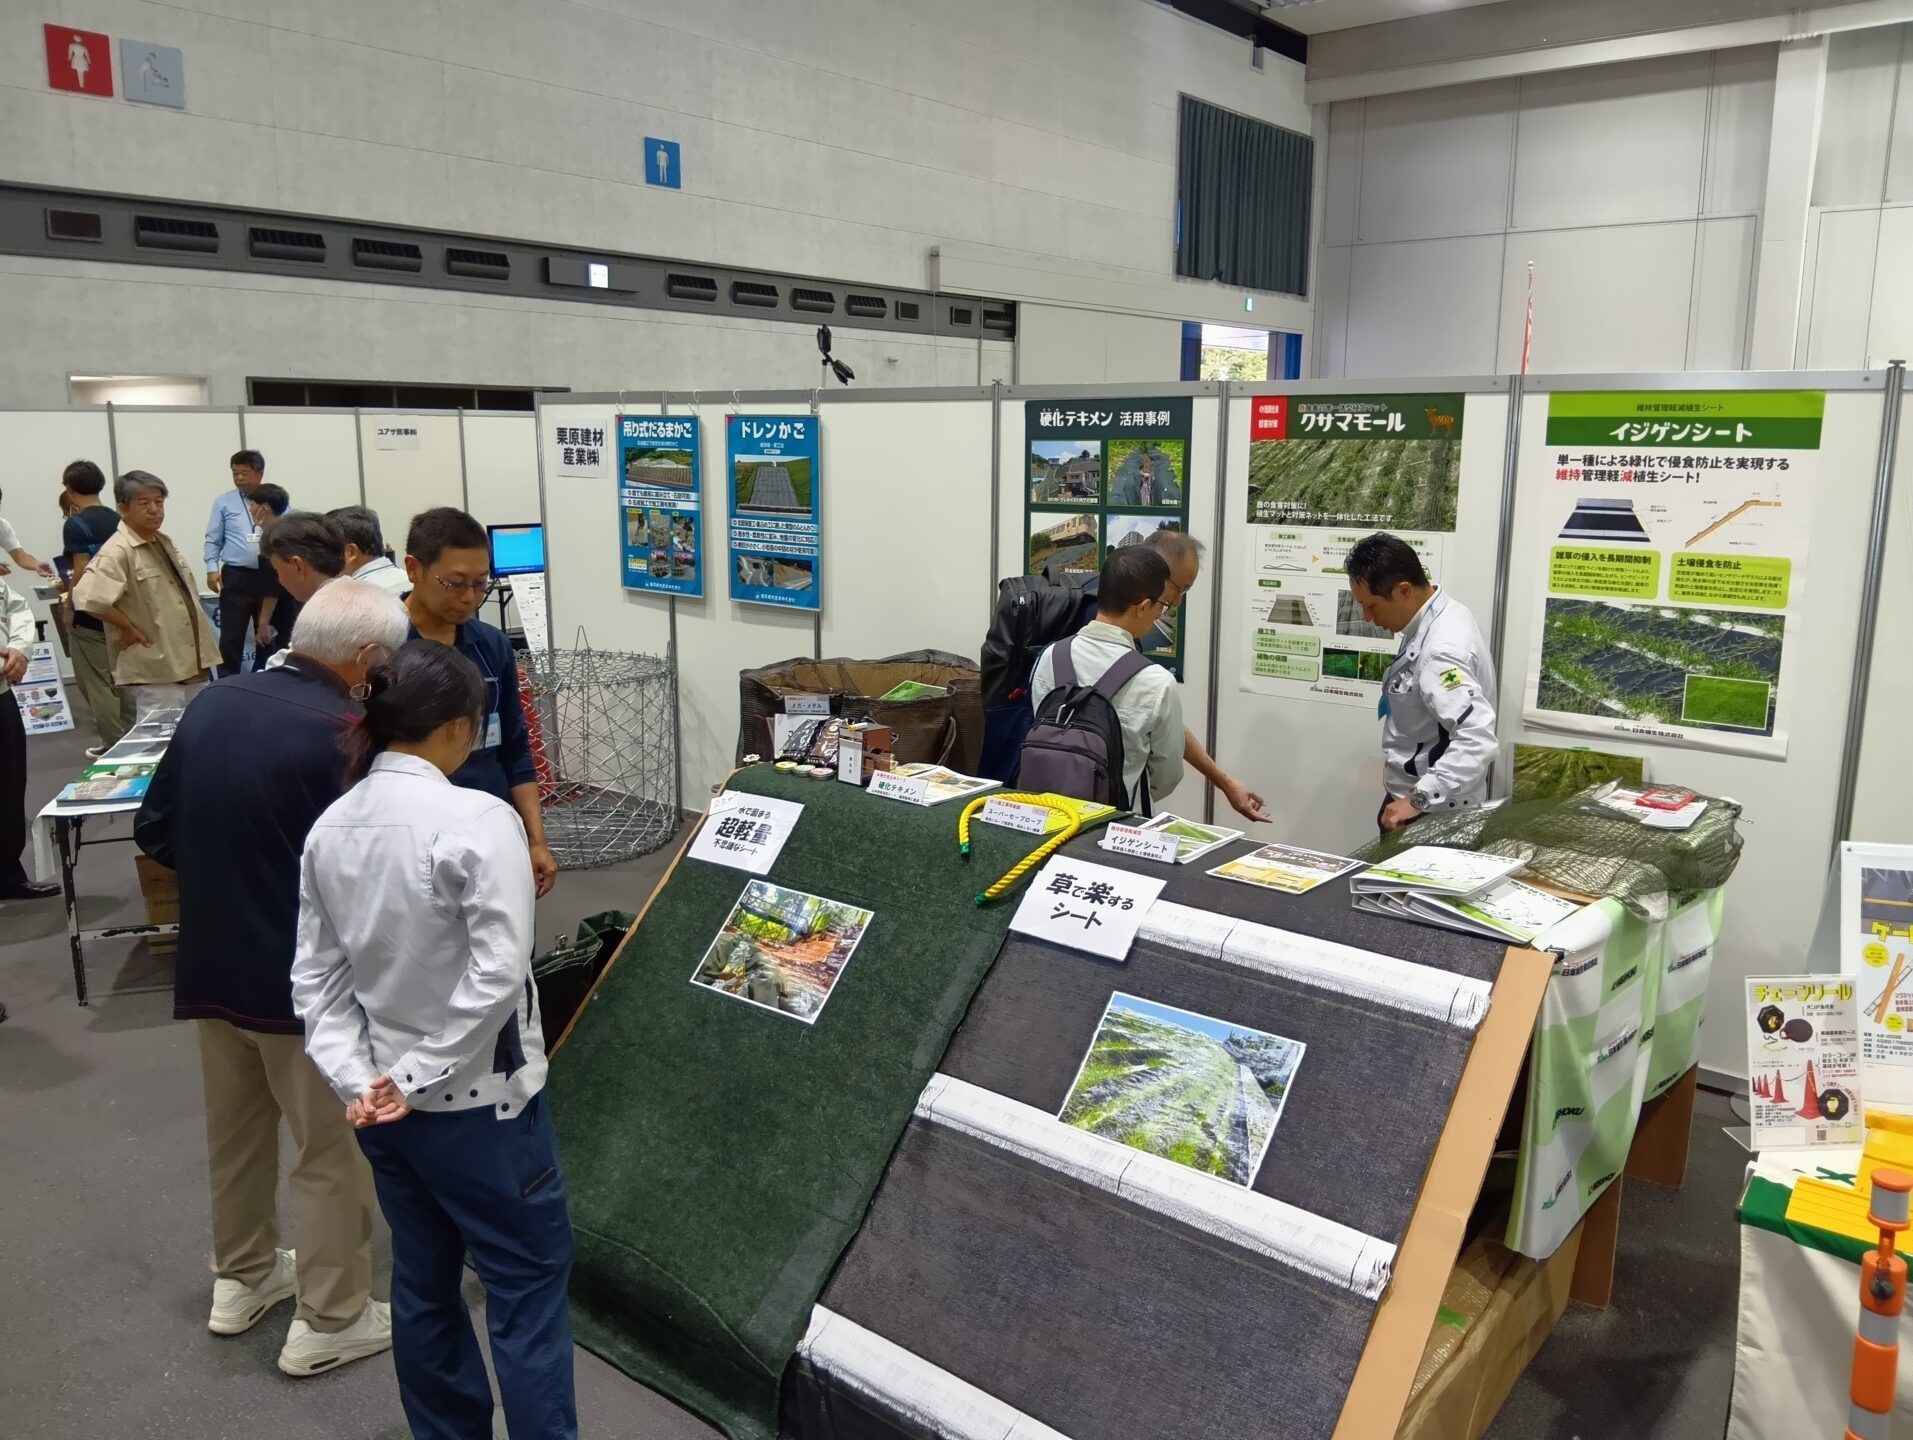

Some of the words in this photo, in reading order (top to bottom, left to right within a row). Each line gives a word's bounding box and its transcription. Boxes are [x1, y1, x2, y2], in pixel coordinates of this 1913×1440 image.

[1637, 403, 1724, 412] 維持管理軽減植生シート
[1040, 411, 1113, 427] 硬化テキメン
[1119, 410, 1171, 427] 活用事例
[1300, 412, 1406, 432] クサマモール
[556, 427, 604, 446] 栗原建材
[623, 421, 693, 439] 吊り式だるまかご
[741, 421, 805, 440] ドレンかご
[1609, 422, 1753, 443] イジゲンシート
[1557, 453, 1790, 471] 単一種による緑化で侵食防止を実現する
[1555, 551, 1652, 565] 雑草の侵入を長期間抑制
[1676, 558, 1742, 570] 土壌侵食を防止
[878, 781, 917, 796] 硬化テキメン
[738, 806, 772, 820] 水で固まる
[714, 816, 773, 846] 超軽量
[713, 838, 758, 856] 不思議なシート
[1111, 835, 1168, 854] イジゲンシート
[1045, 872, 1135, 911] 草で楽する
[1050, 901, 1103, 930] シート
[1871, 921, 1913, 944] ゲー
